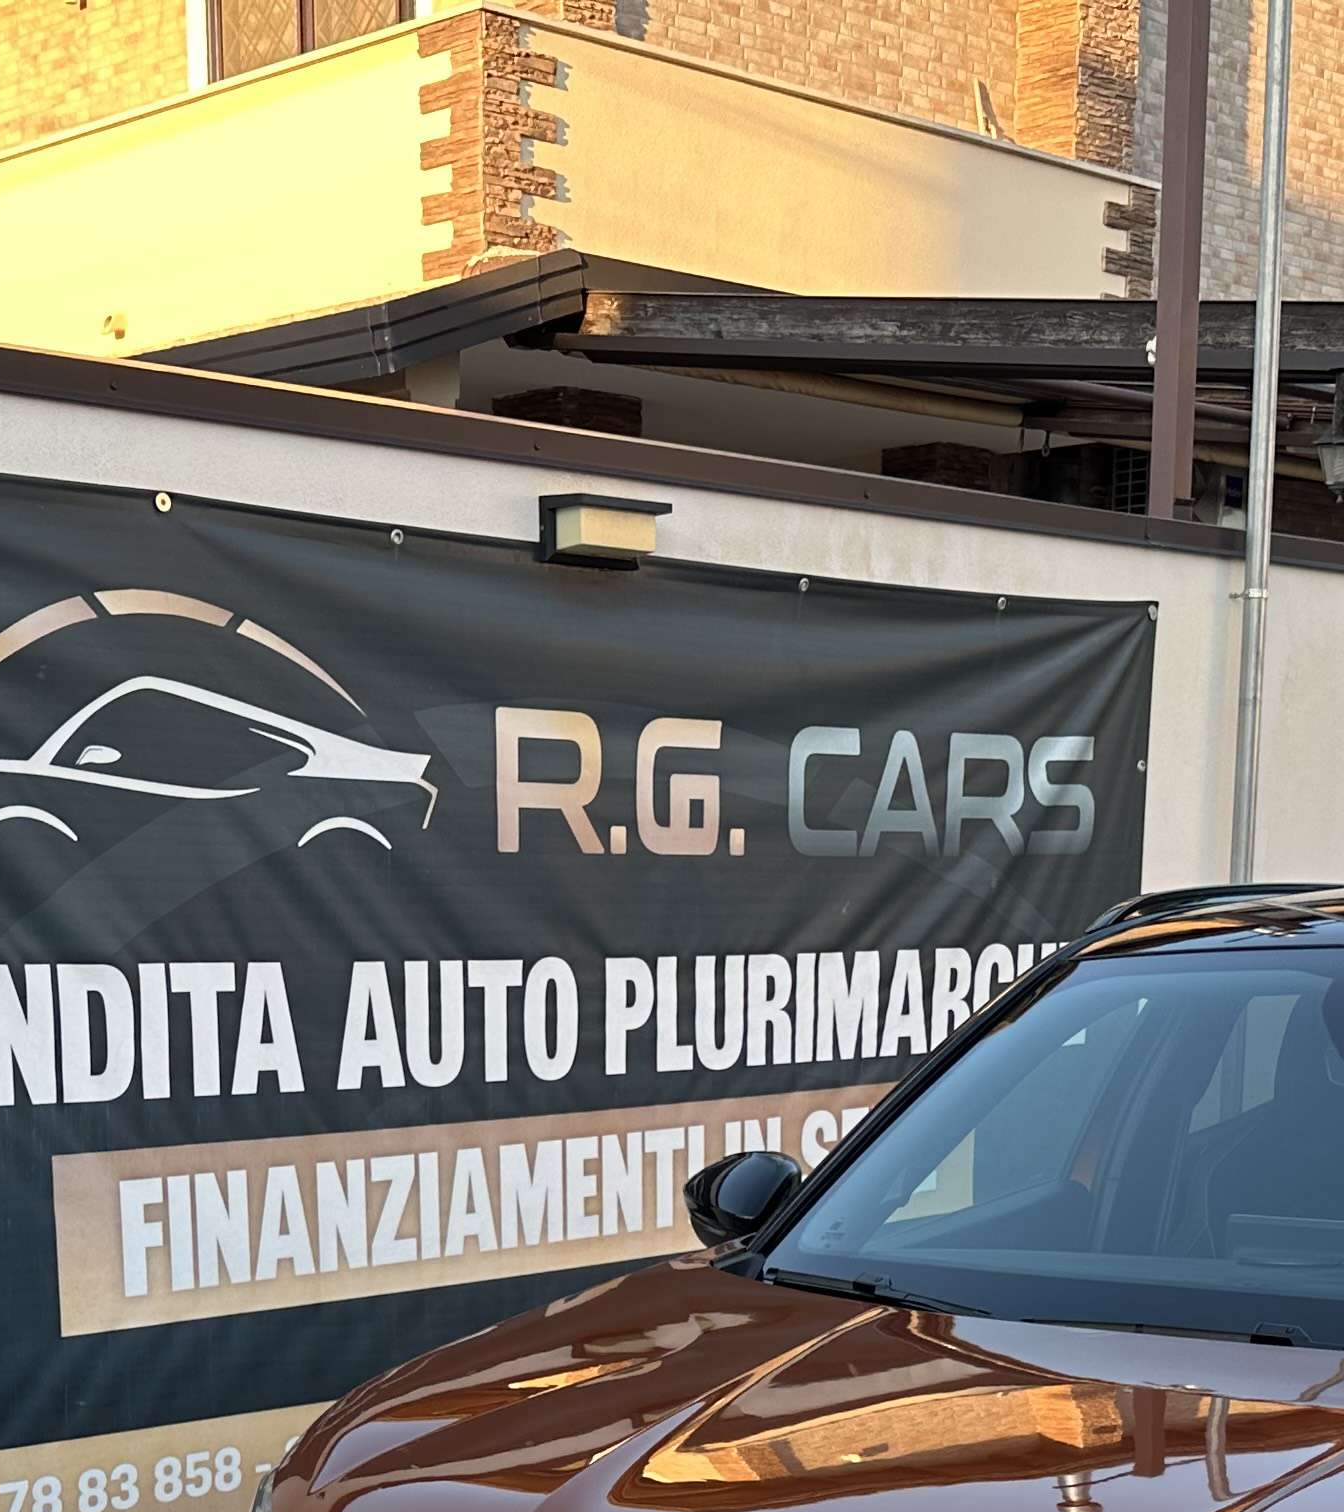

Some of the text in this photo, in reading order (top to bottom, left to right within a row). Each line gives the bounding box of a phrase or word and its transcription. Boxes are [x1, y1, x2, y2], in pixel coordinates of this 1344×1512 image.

[495, 706, 1095, 856] R.G. CARS
[337, 956, 579, 1090] AUTO
[605, 942, 1069, 1076] PLURIMARC
[153, 1446, 242, 1502] 858
